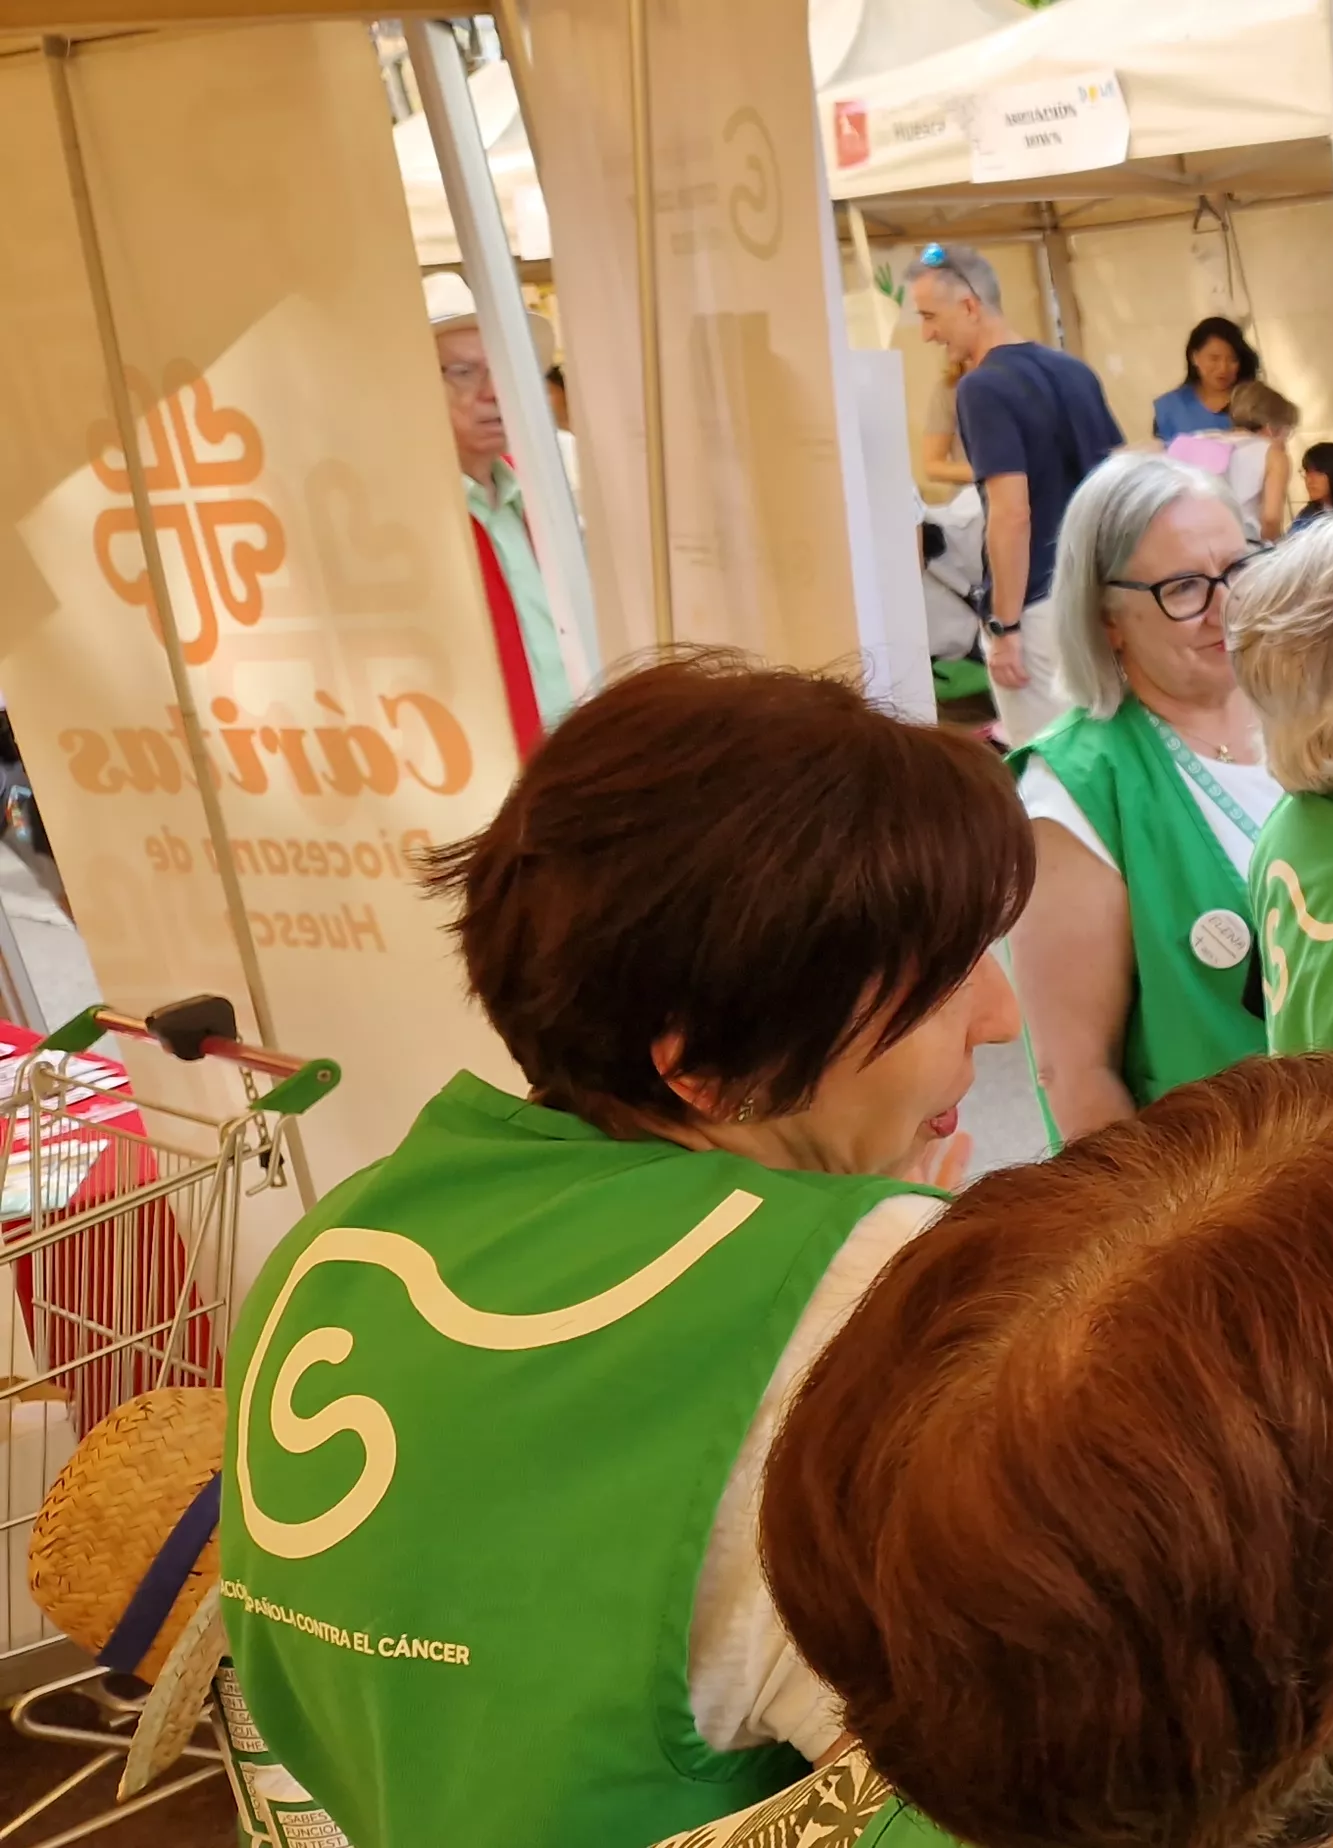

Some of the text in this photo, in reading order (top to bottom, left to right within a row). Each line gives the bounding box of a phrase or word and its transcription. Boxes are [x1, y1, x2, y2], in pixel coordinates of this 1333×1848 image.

[296, 1613, 351, 1649] CONTRA
[353, 1631, 375, 1655] EL
[378, 1633, 470, 1666] CÁNCER
